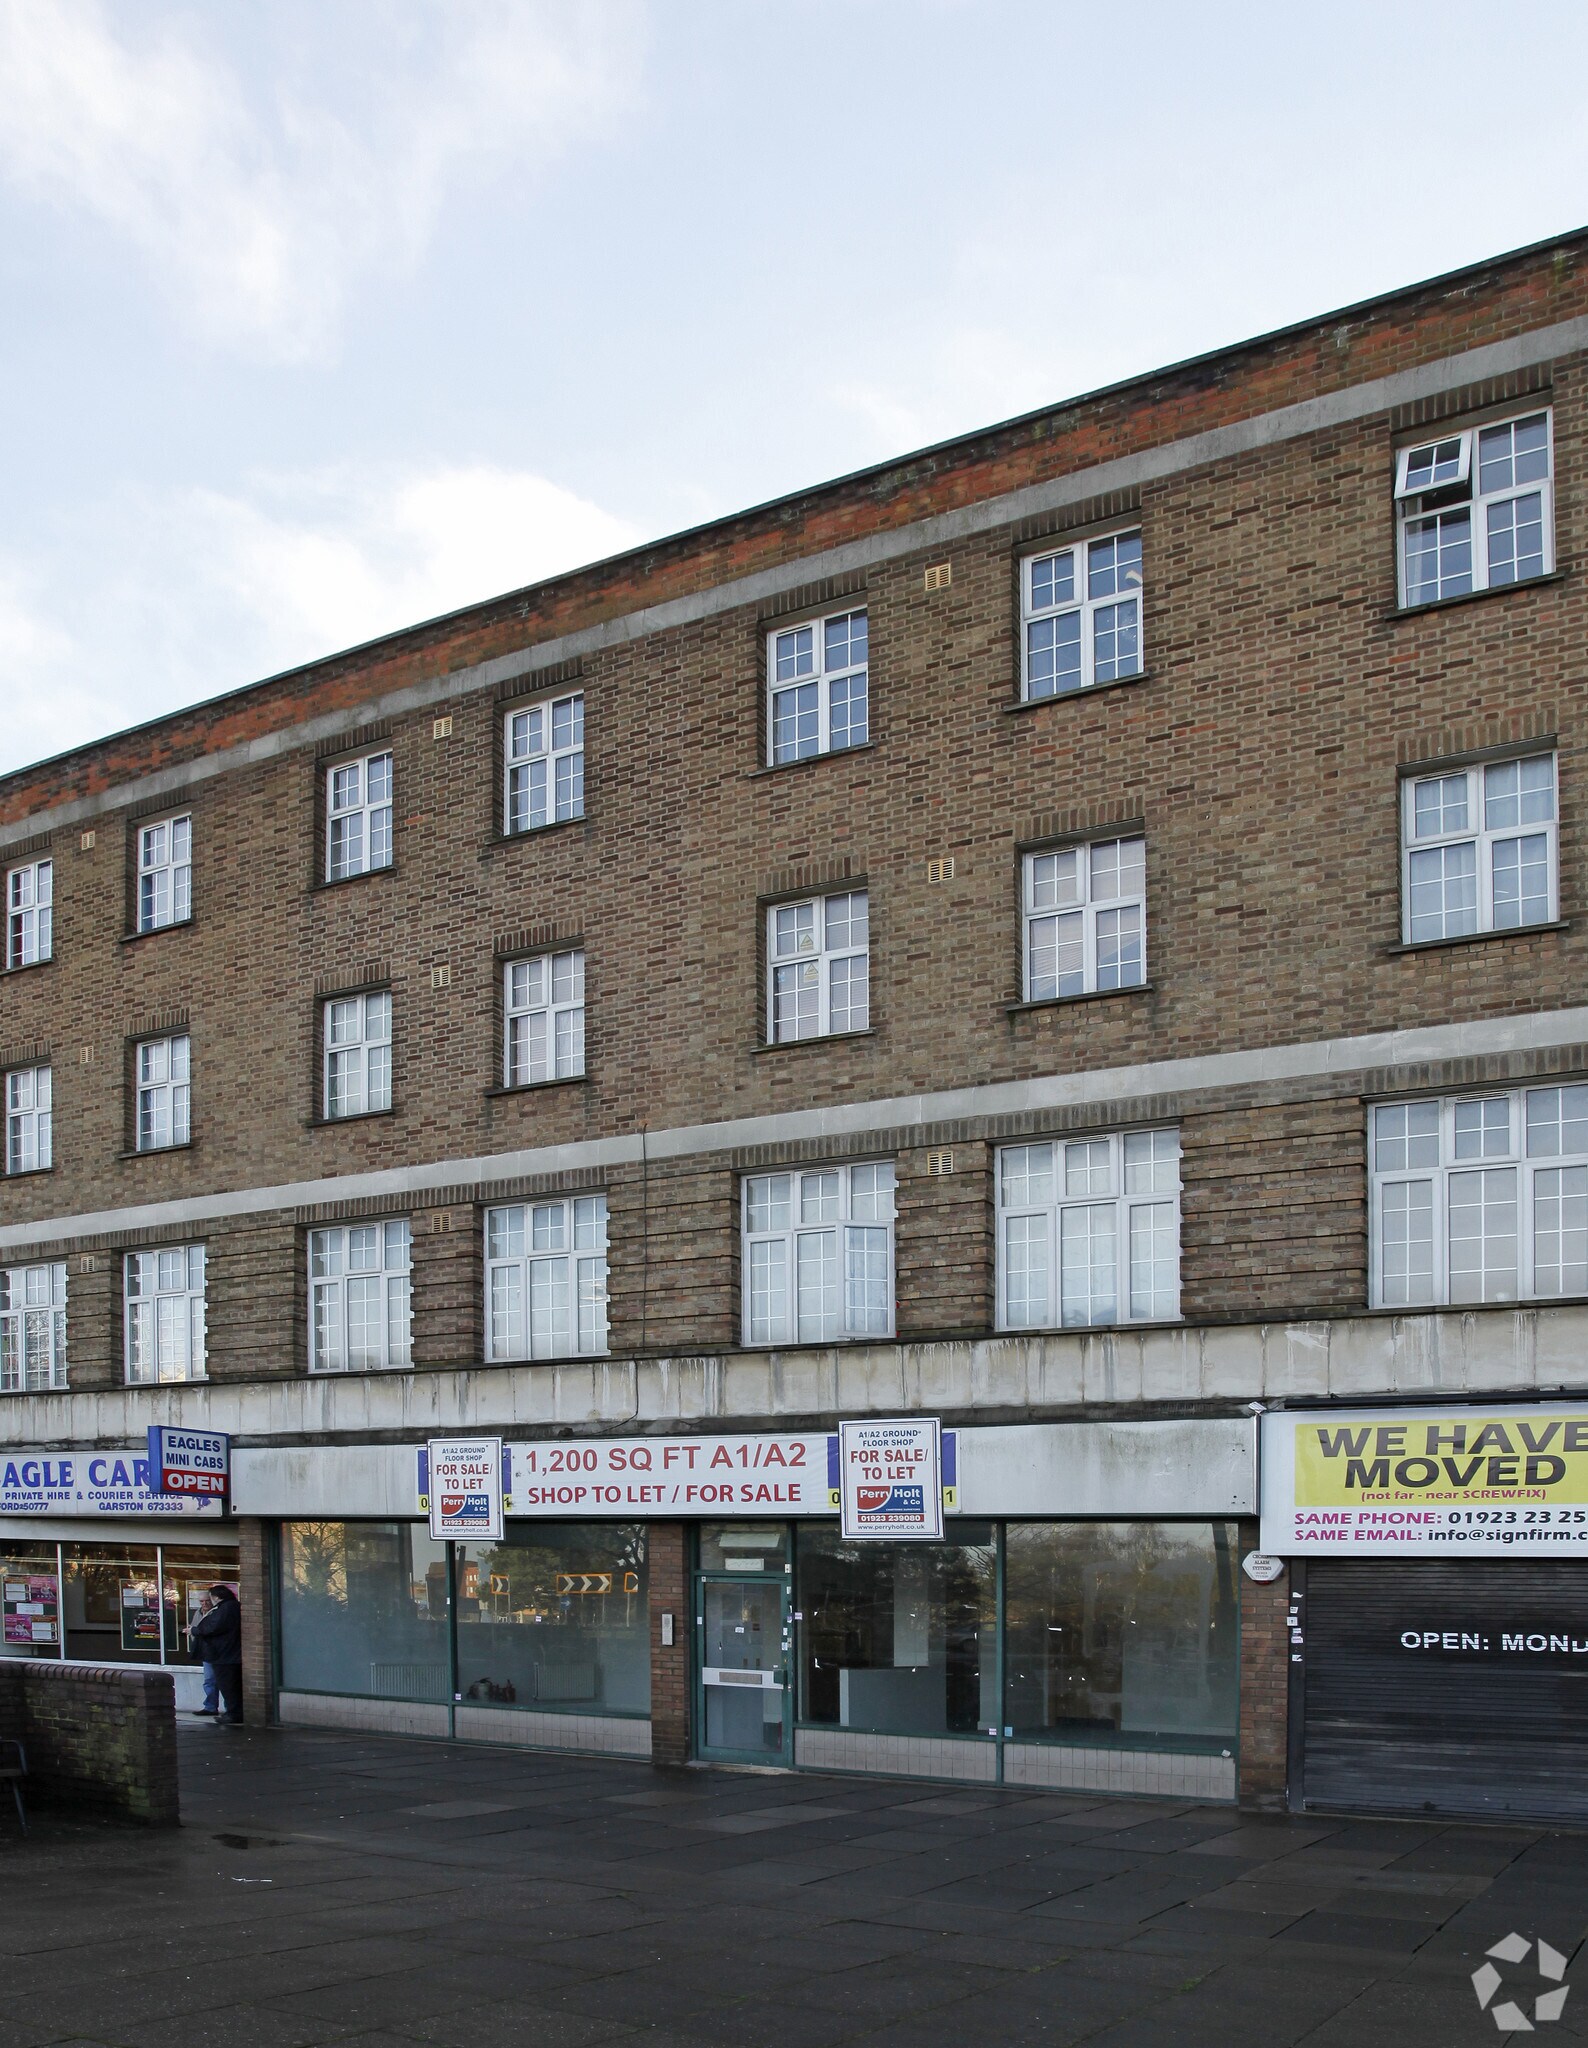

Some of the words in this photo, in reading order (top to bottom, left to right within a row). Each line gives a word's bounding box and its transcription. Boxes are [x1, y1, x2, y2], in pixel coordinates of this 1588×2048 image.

[858, 1431, 880, 1439] A1/A2
[882, 1430, 918, 1438] GROUND
[1316, 1426, 1407, 1457] WE
[1424, 1421, 1588, 1455] HAVE
[167, 1435, 221, 1453] EAGLES
[891, 1439, 914, 1447] SHOP
[166, 1452, 190, 1466] MINI
[194, 1455, 224, 1469] CABS
[526, 1449, 598, 1476] 1,200
[608, 1447, 652, 1471] SQ
[663, 1446, 701, 1469] FT
[710, 1442, 807, 1469] A1/A2
[850, 1450, 879, 1463] FOR
[884, 1449, 928, 1463] SALE/
[0, 1461, 75, 1488] AGLE
[436, 1464, 457, 1475] FOR
[461, 1463, 493, 1475] SALE/
[862, 1467, 882, 1480] TO
[887, 1466, 915, 1479] LET
[1344, 1455, 1566, 1488] MOVED
[167, 1473, 224, 1492] OPEN
[445, 1479, 460, 1490] TO
[463, 1478, 484, 1489] LET
[5, 1491, 43, 1500] PRIVATE
[47, 1491, 71, 1500] HIRE
[76, 1490, 83, 1500] &
[87, 1491, 134, 1500] COURIER
[528, 1486, 586, 1504] SHOP
[591, 1486, 621, 1504] TO
[627, 1485, 666, 1503] LET
[686, 1484, 734, 1503] FOR
[740, 1483, 801, 1502] SALE
[860, 1489, 891, 1499] Perry
[894, 1488, 920, 1498] Holt
[1361, 1491, 1391, 1503] (not
[1395, 1490, 1415, 1500] far
[1426, 1491, 1459, 1500] near
[1463, 1489, 1547, 1500] SCREWFIX)
[98, 1502, 143, 1511] GARSTON
[147, 1502, 183, 1511] 673333
[443, 1497, 465, 1506] Perry
[467, 1497, 488, 1506] Holt
[1294, 1513, 1352, 1525] SAME
[1358, 1512, 1442, 1524] PHONE:
[1448, 1511, 1517, 1524] 01923
[1524, 1511, 1552, 1524] 23
[1294, 1530, 1348, 1541] SAME
[1354, 1529, 1422, 1541] EMAIL:
[1400, 1631, 1489, 1650] OPEN:
